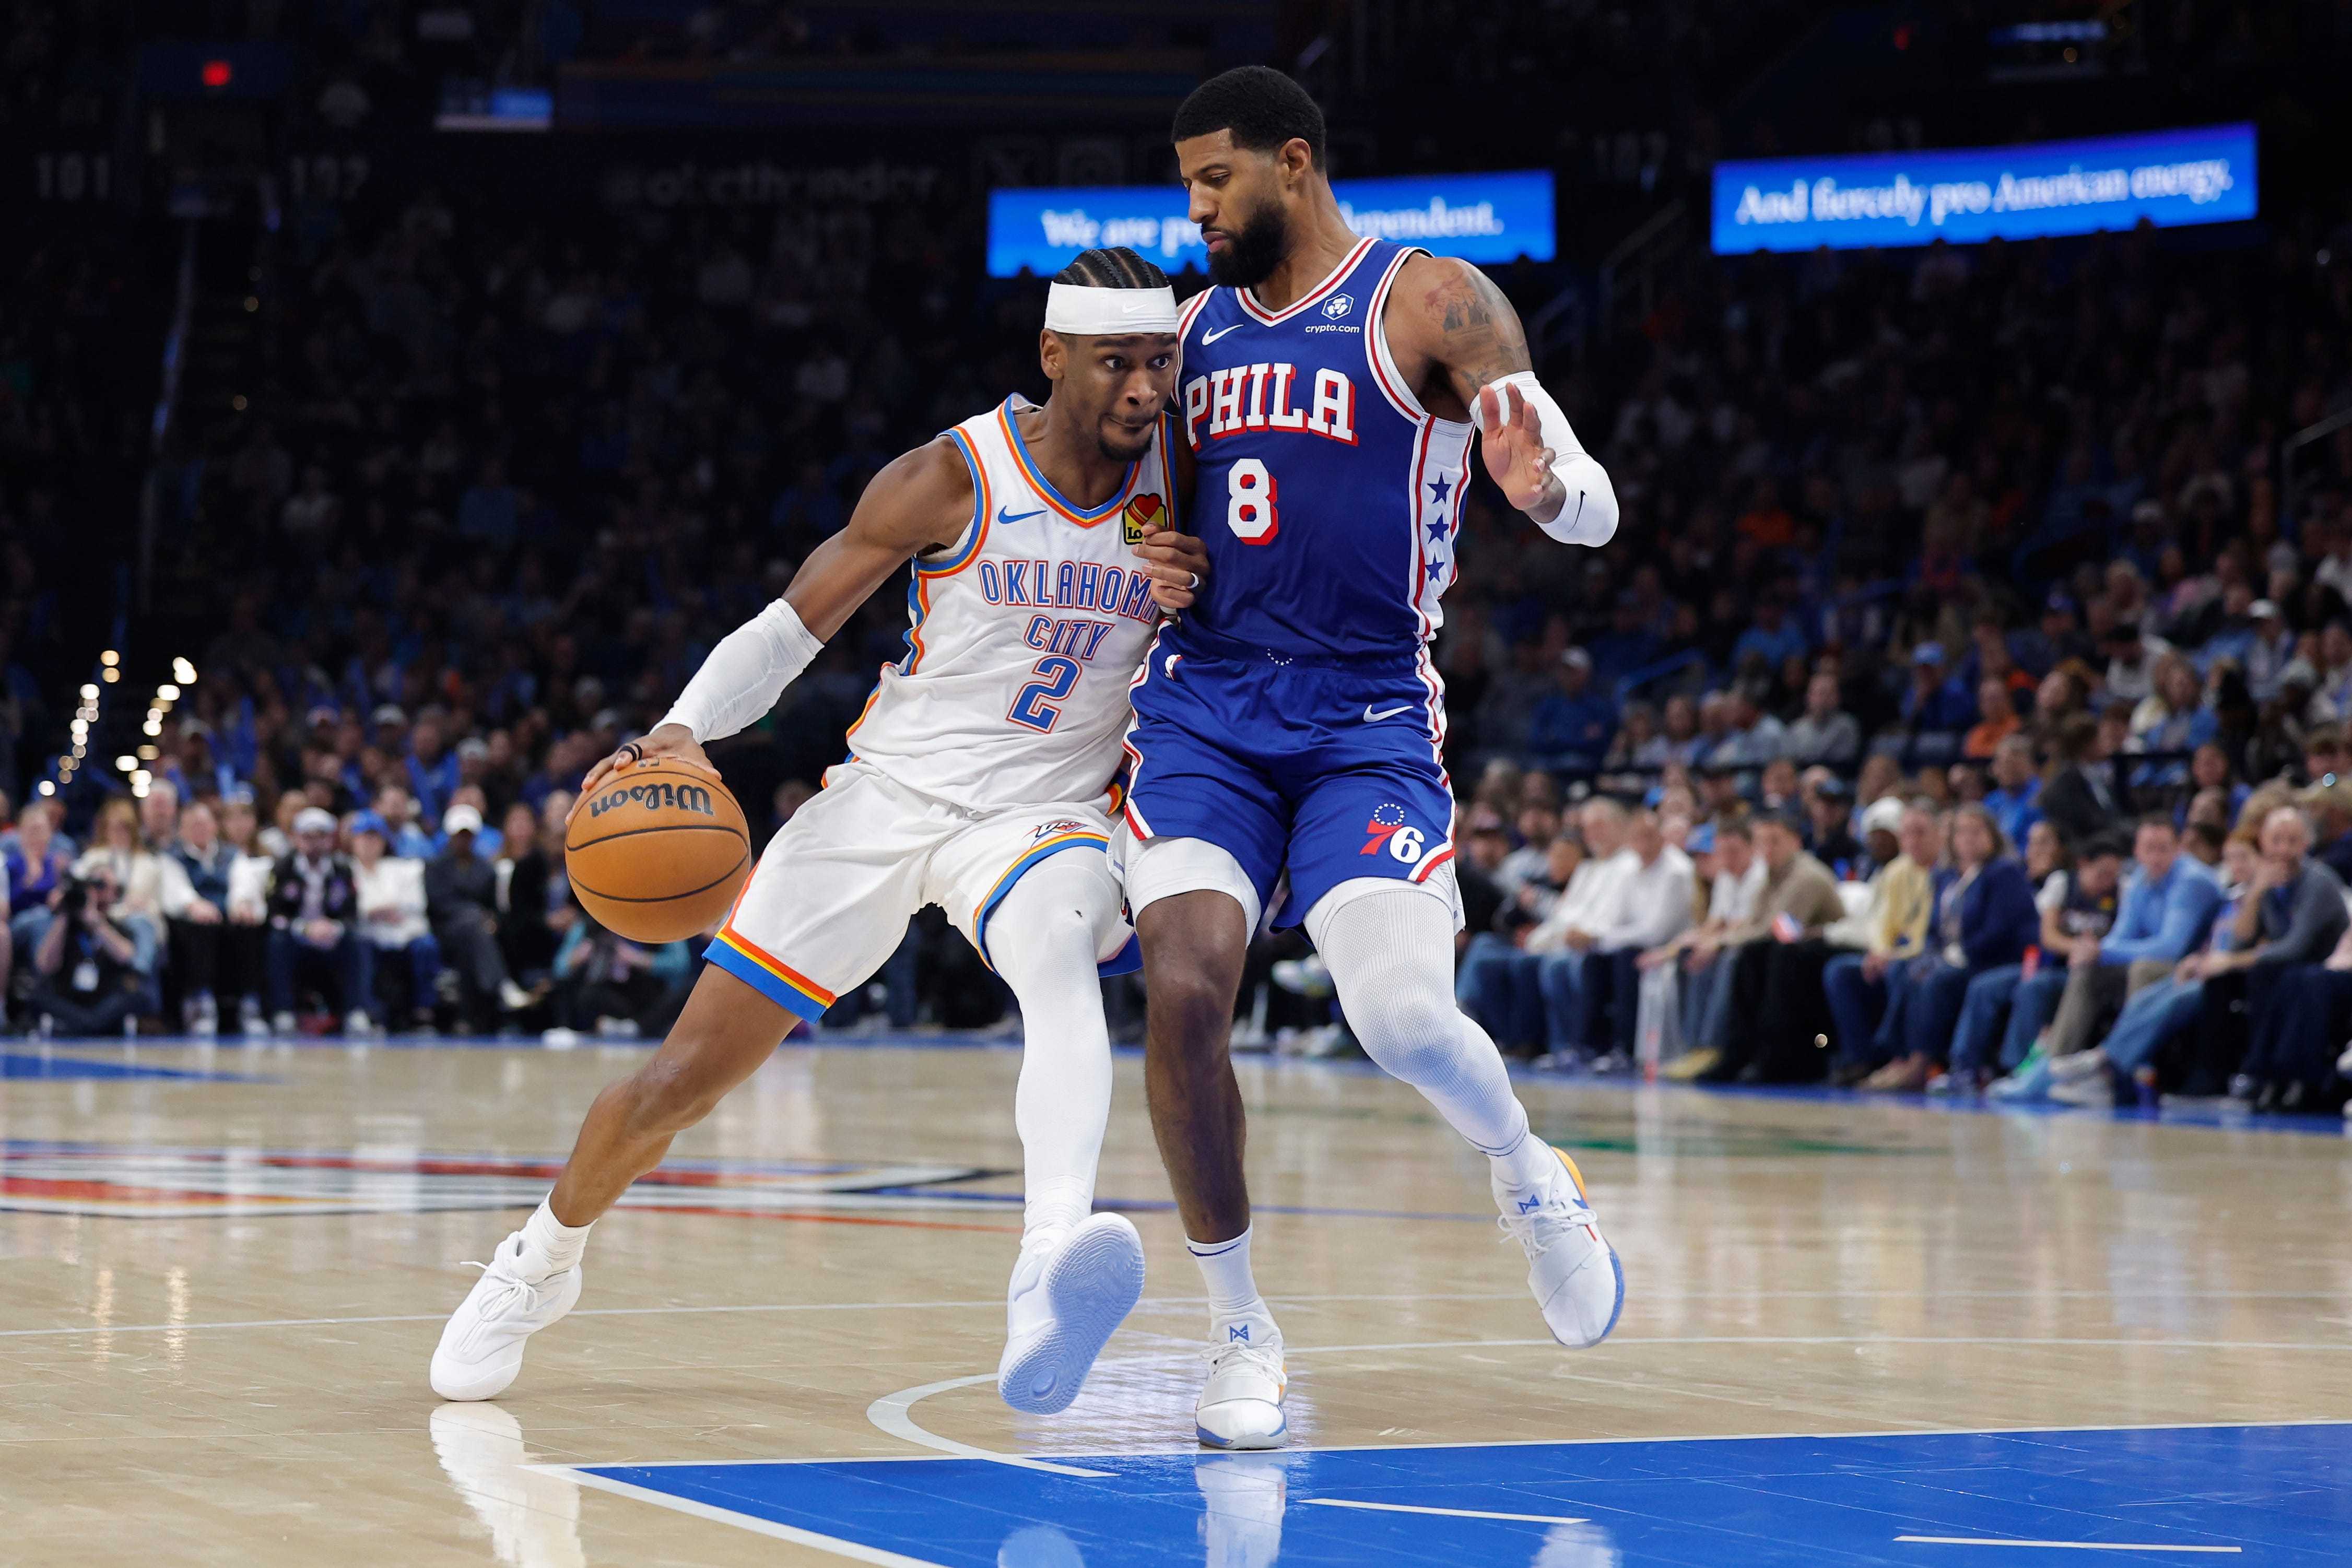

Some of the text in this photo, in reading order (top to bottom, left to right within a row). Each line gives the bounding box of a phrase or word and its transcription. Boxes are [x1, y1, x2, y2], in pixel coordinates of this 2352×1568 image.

[1735, 179, 1809, 225] And
[1930, 181, 1991, 226] pro
[1992, 164, 2130, 213] American
[1042, 209, 1100, 247] We
[1101, 217, 1160, 248] are
[1305, 324, 1360, 334] crypto.com
[1185, 362, 1359, 452] PHILA
[1228, 458, 1279, 546] 8
[1024, 614, 1116, 661] CITY
[1005, 654, 1083, 734] 2
[590, 783, 715, 818] Wilson
[1360, 819, 1426, 864] 76
